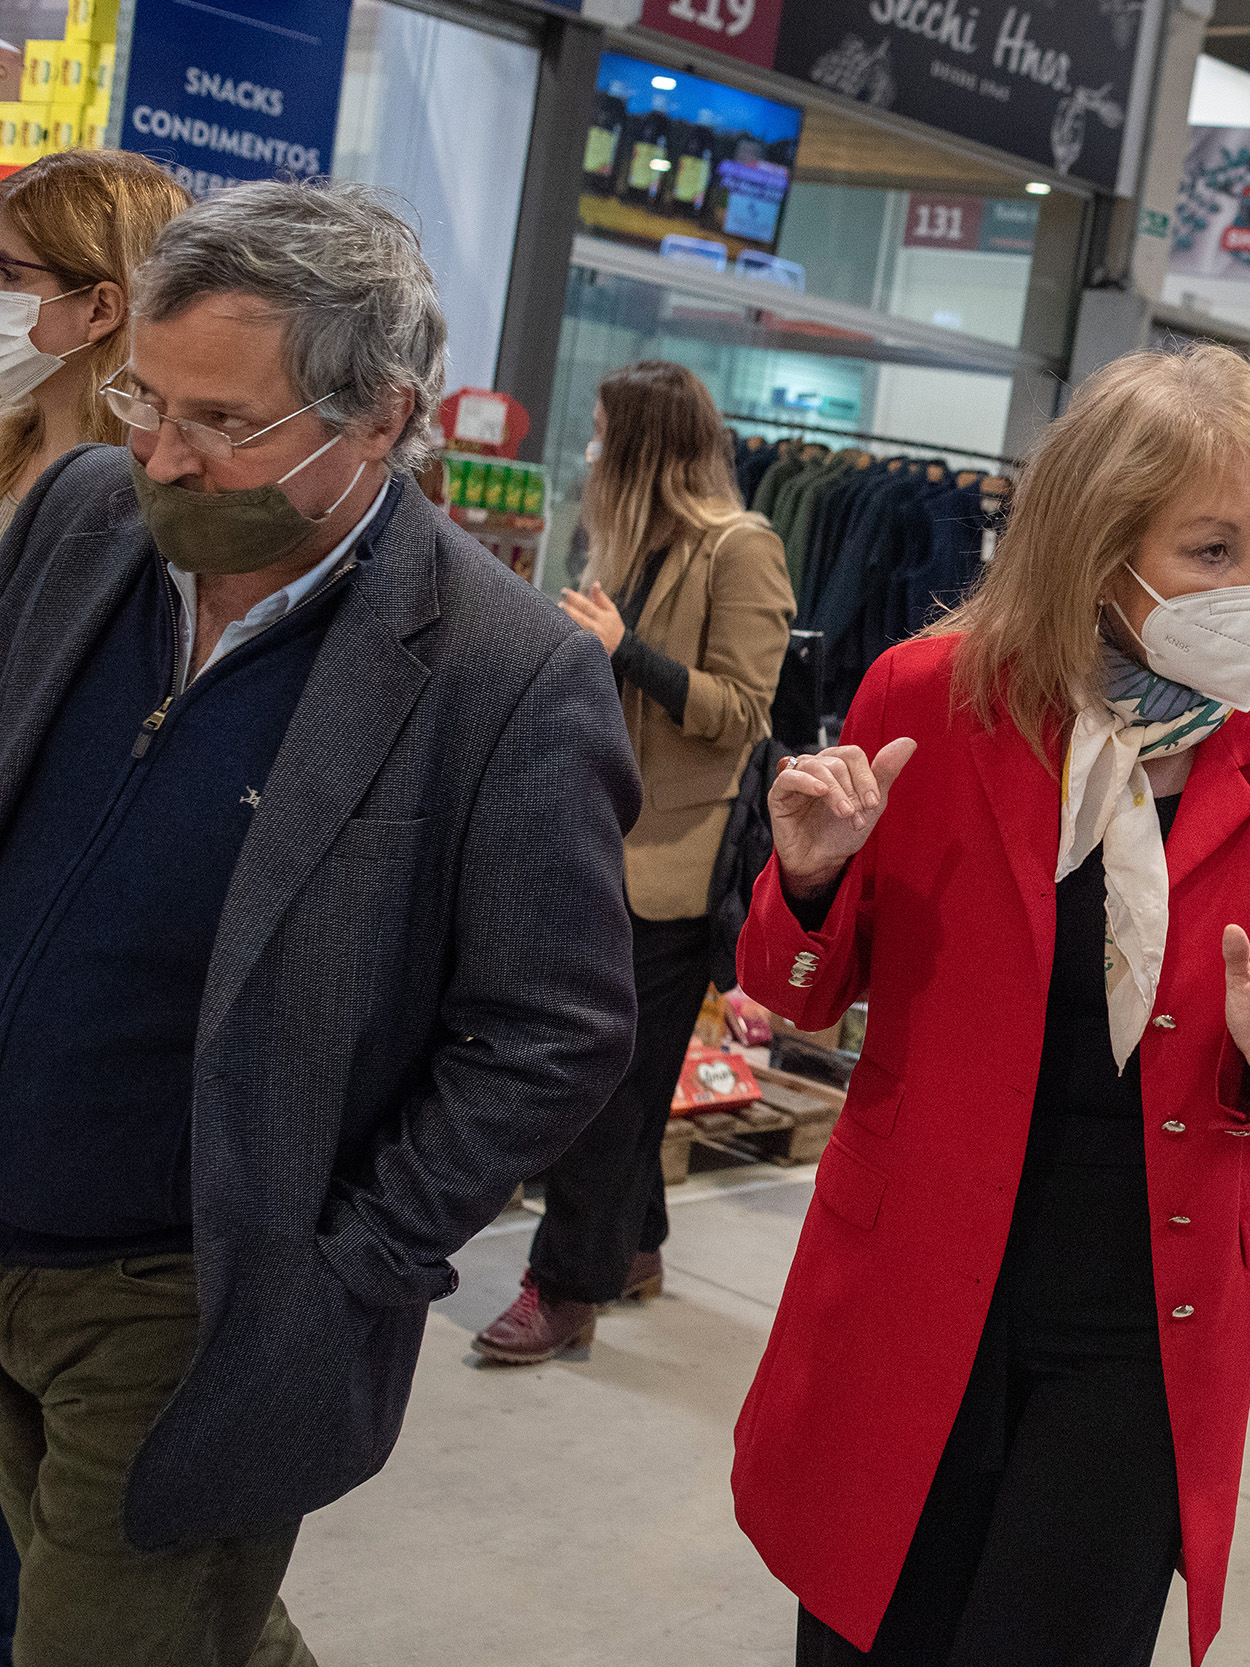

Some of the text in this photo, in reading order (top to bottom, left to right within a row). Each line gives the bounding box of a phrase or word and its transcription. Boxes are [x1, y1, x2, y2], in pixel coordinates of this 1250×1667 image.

[185, 66, 284, 117] SNACKS
[132, 105, 321, 174] CONDIMENTOS
[915, 205, 964, 240] 131
[1165, 635, 1191, 654] KN95
